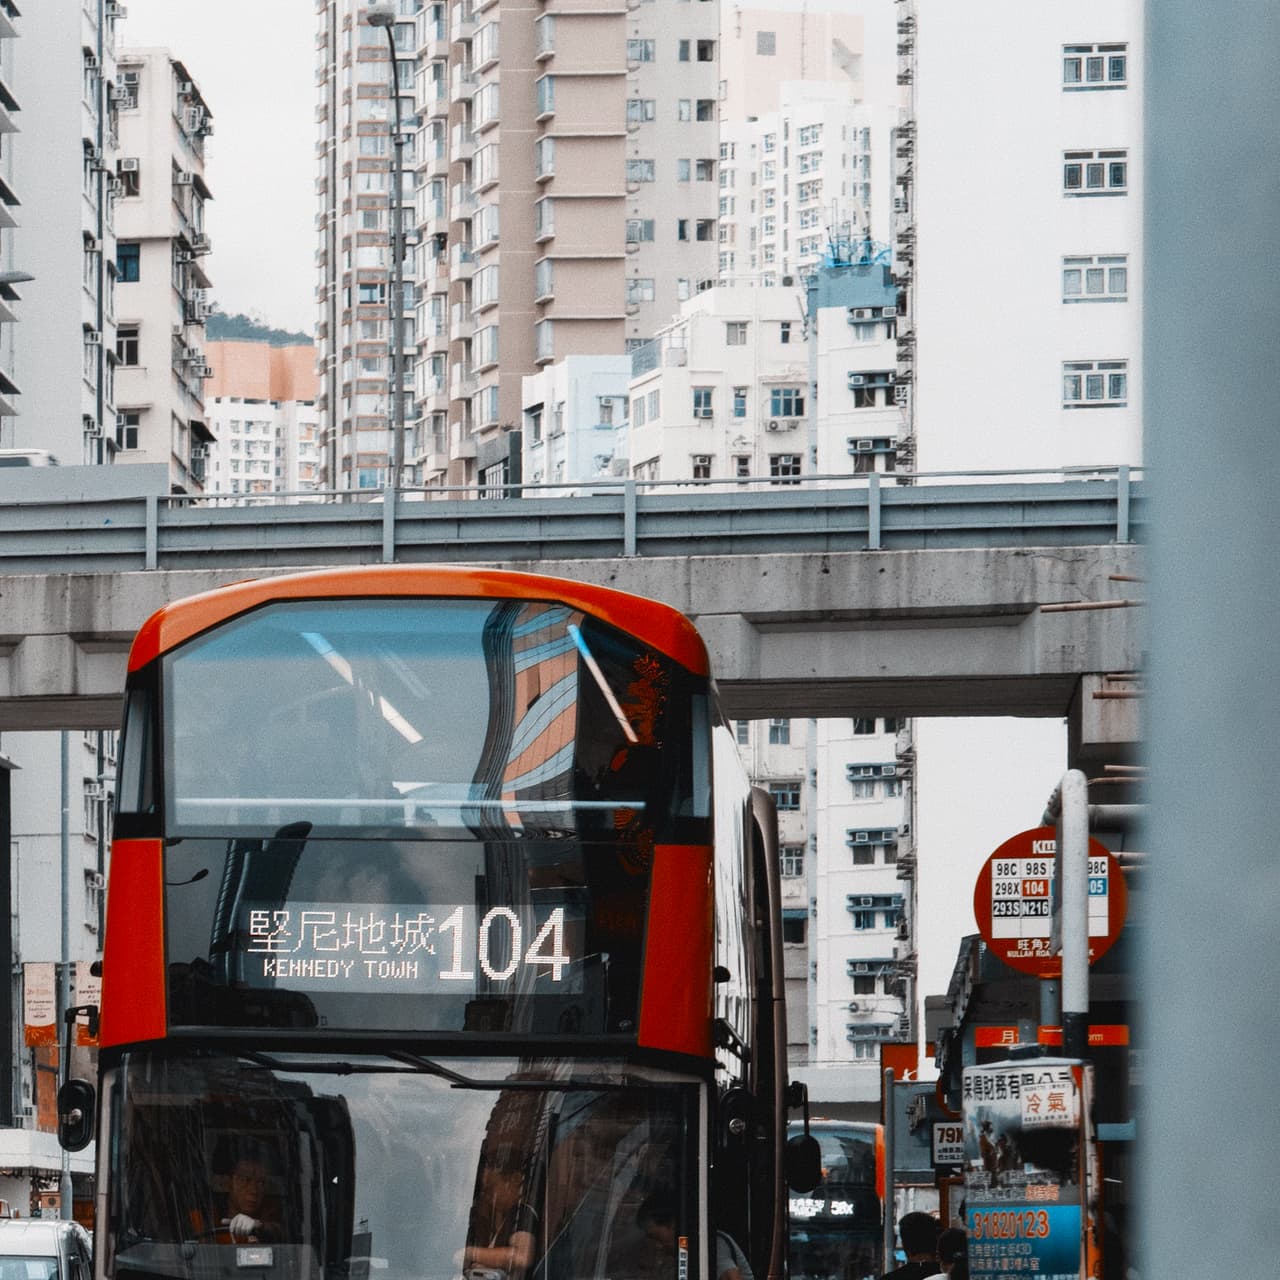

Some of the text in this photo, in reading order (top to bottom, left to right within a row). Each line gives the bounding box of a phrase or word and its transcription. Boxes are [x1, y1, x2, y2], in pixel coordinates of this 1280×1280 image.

[1032, 840, 1056, 854] KM
[997, 863, 1017, 875] 98C
[1026, 863, 1046, 875] 98S
[995, 882, 1019, 896] 298X
[1024, 881, 1044, 895] 104
[993, 901, 1048, 915] 293S N216
[247, 906, 570, 982] 堅尼地城 104
[263, 959, 419, 979] KENNEDY TOWN
[1026, 1092, 1066, 1114] 冷氣
[974, 1210, 1050, 1240] 31820123
